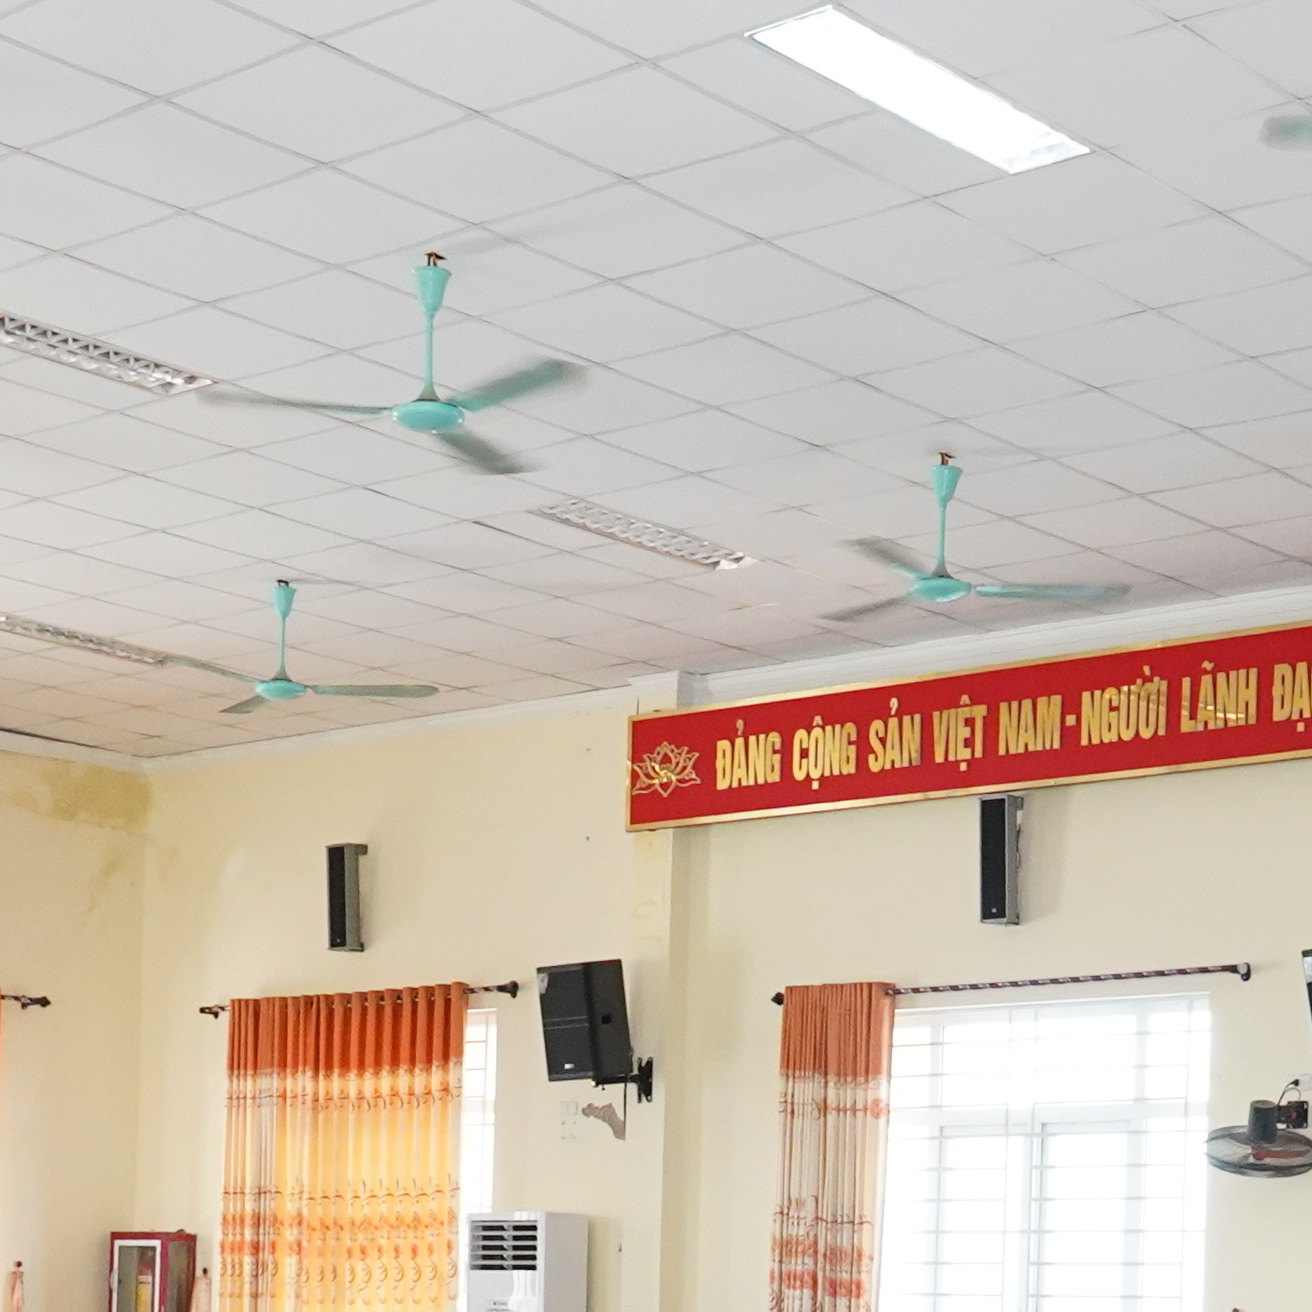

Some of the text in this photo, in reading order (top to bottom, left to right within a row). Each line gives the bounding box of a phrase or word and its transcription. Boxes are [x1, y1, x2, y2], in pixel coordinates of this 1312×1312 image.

[715, 719, 782, 790] ĐẢNG
[792, 715, 857, 790] CỘNG
[868, 697, 922, 773] SẢN
[932, 694, 988, 771] VIỆT
[1180, 660, 1258, 733] LÃNH
